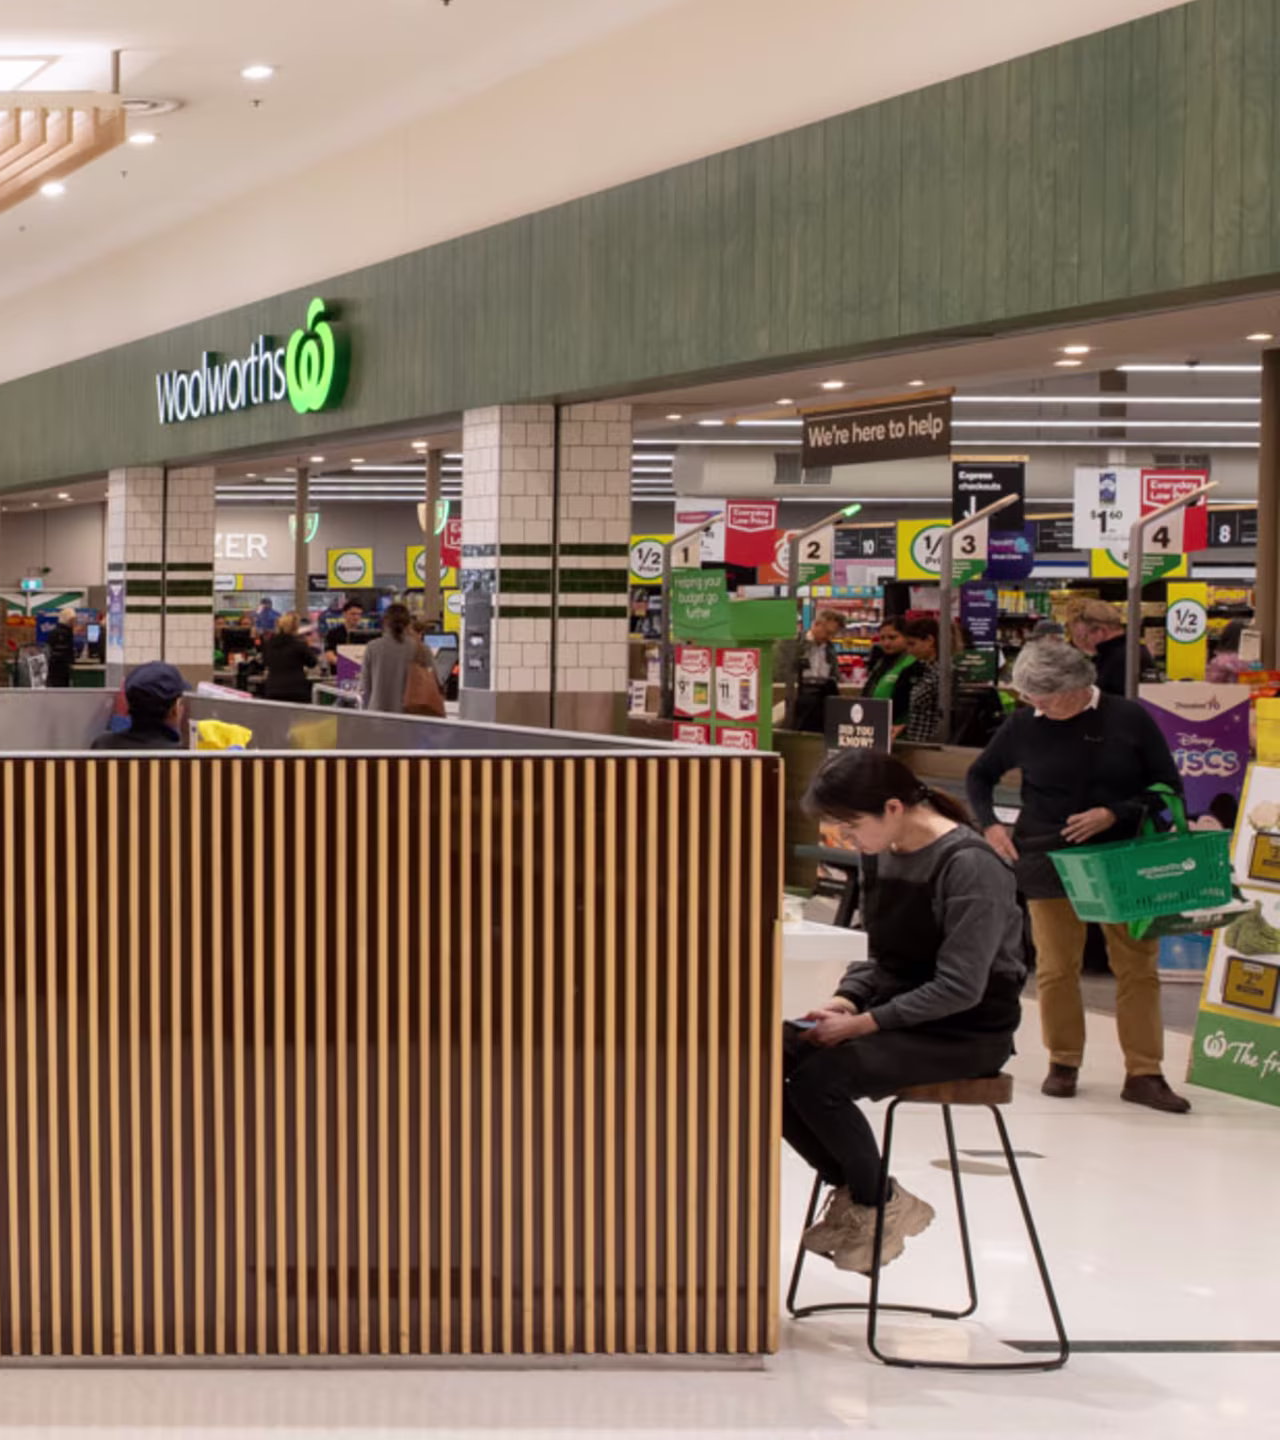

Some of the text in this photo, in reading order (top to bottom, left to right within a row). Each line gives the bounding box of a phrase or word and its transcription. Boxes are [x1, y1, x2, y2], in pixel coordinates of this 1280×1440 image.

[808, 413, 943, 448] We're here to help
[958, 471, 994, 482] Express
[1151, 525, 1171, 549] 4
[1218, 524, 1231, 544] 8
[806, 541, 821, 560] 2
[862, 538, 875, 555] 10
[960, 535, 976, 554] 3
[637, 547, 662, 566] 1/2
[681, 547, 690, 564] 1
[637, 564, 661, 573] Price
[1175, 608, 1198, 627] 1/2
[1175, 625, 1197, 635] Price
[856, 725, 874, 736] YOU
[838, 735, 875, 749] KNOW?
[1229, 1040, 1260, 1068] The
